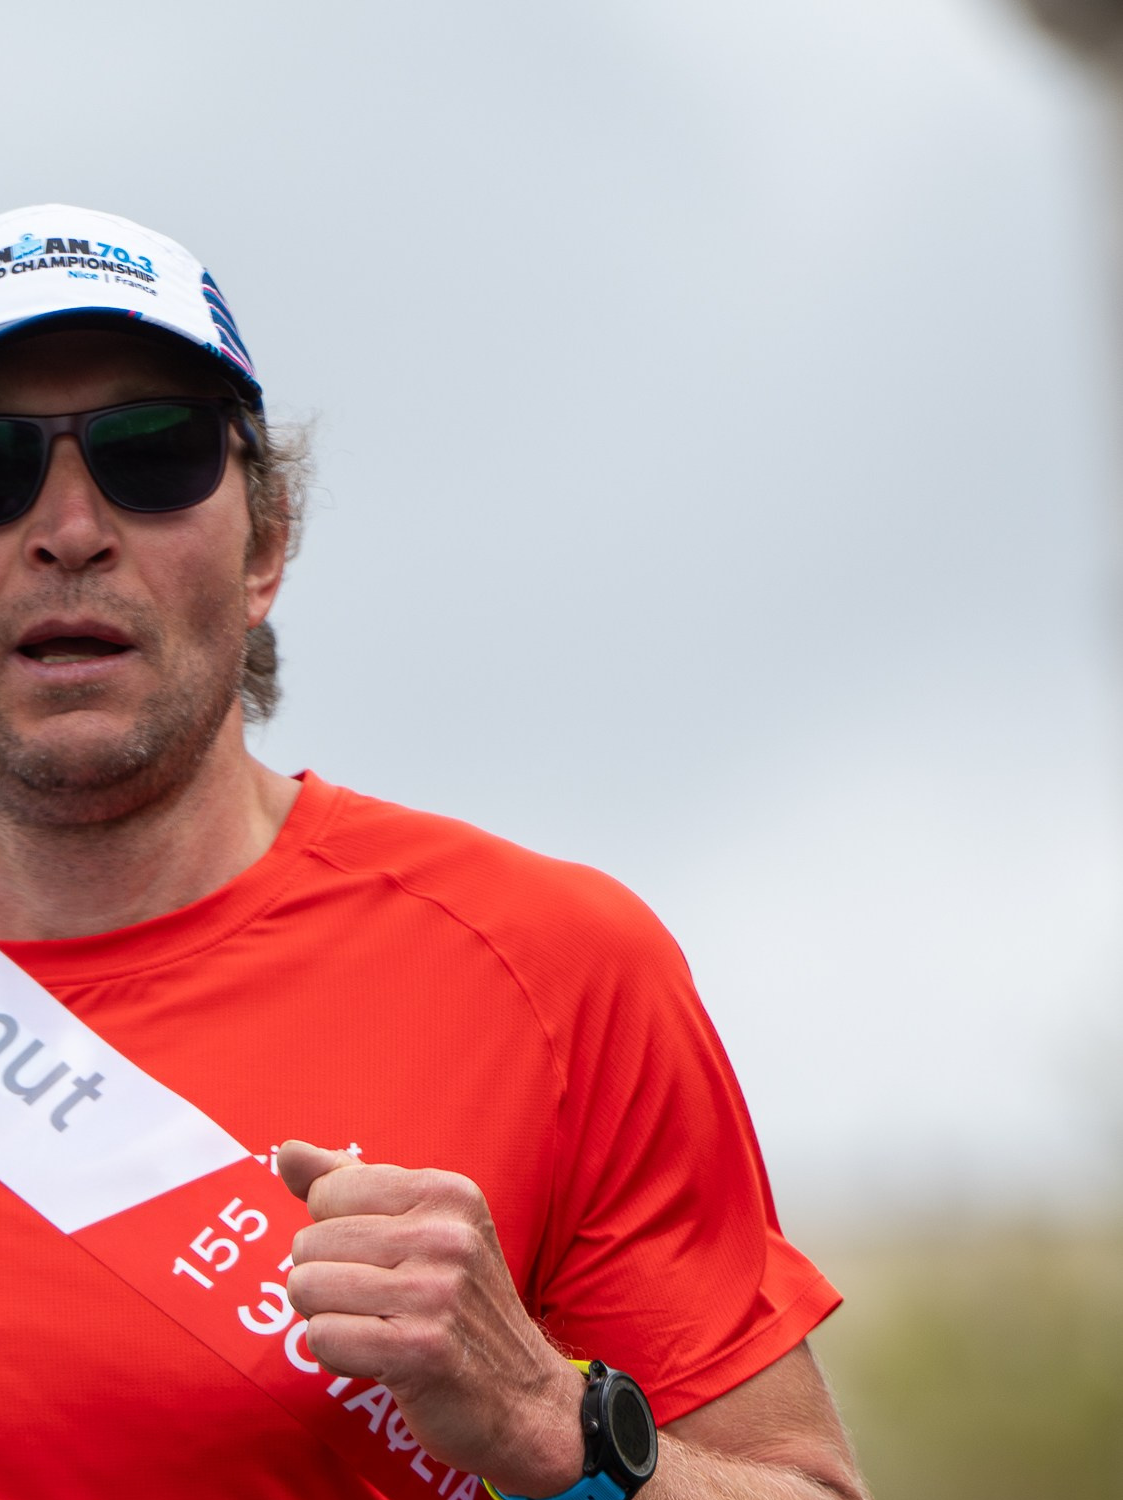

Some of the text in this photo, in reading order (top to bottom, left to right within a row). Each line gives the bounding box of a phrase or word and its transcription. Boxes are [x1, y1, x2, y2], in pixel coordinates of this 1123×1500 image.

[11, 256, 155, 283] CHAMPIONSHIP
[67, 270, 99, 281] Nice
[114, 275, 158, 296] France
[172, 1197, 268, 1289] 155
